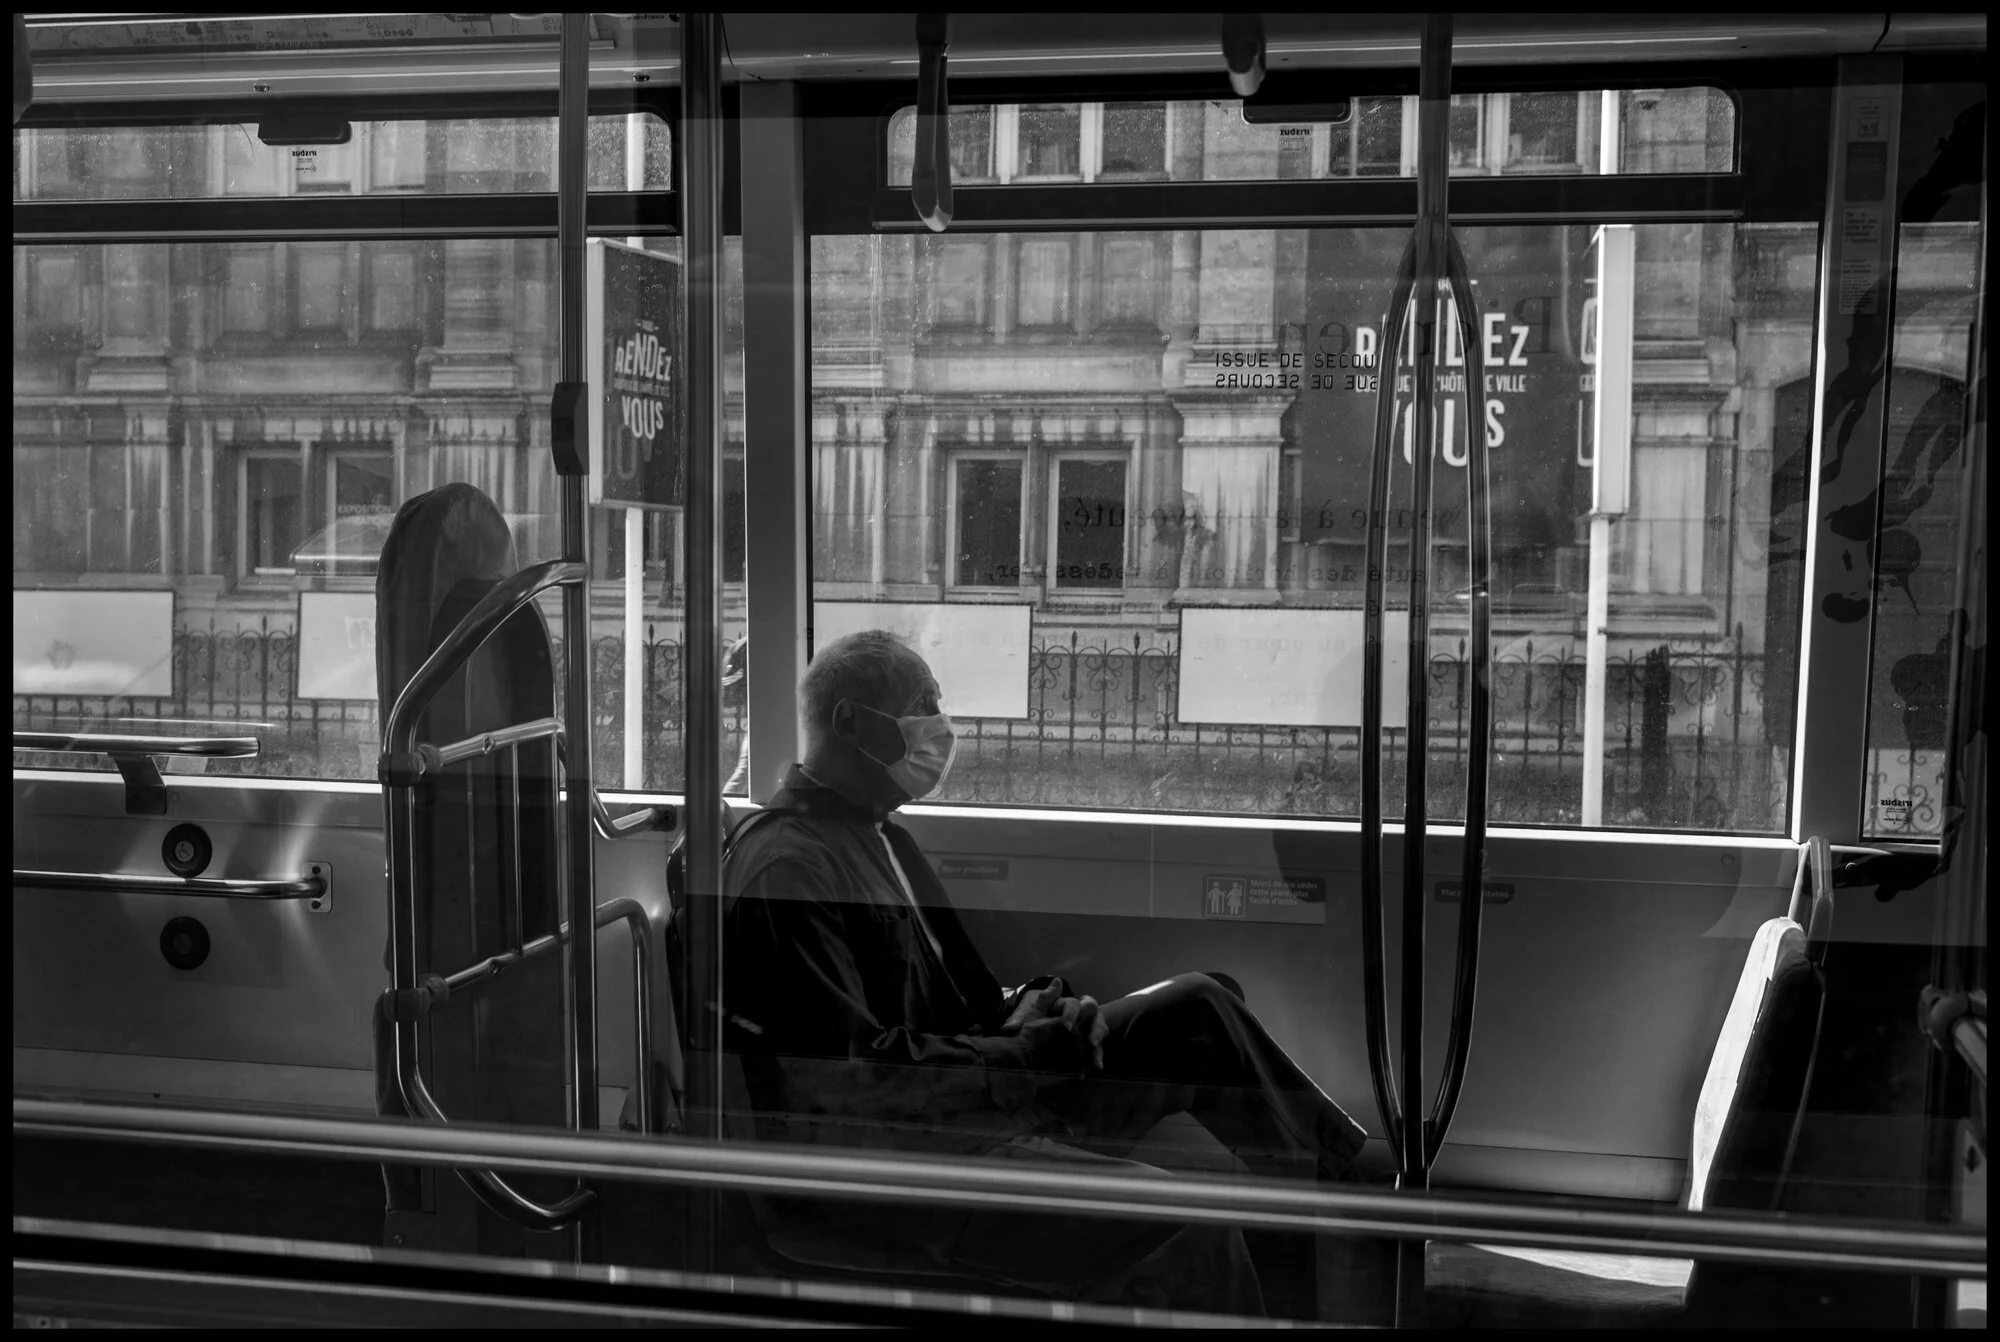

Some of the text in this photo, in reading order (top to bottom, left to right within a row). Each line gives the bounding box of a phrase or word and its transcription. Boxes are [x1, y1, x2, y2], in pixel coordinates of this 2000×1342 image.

[614, 332, 672, 382] RENDEZ
[1216, 353, 1375, 369] ISSUE DE SECOU
[621, 395, 664, 440] VOUS
